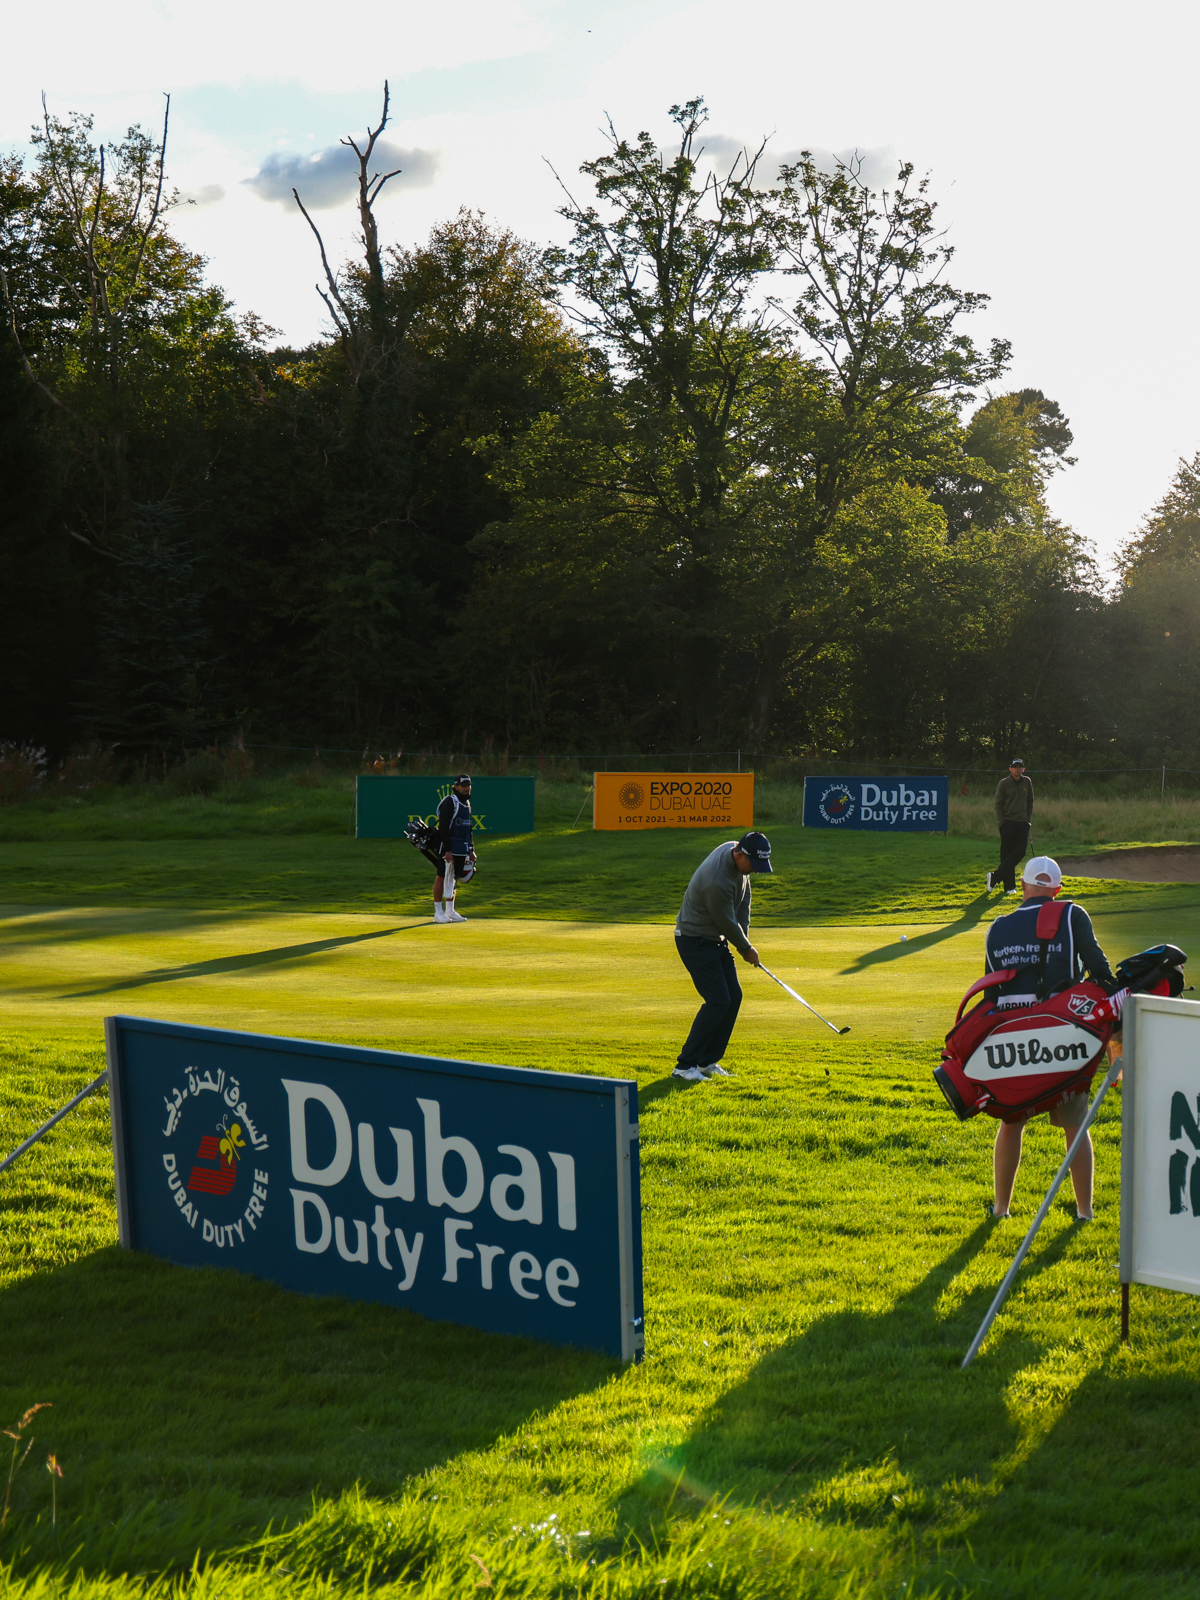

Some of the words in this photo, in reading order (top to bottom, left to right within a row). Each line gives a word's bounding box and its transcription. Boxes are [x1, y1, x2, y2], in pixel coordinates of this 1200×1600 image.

[650, 782, 693, 796] EXPO
[694, 782, 732, 795] 2020
[860, 783, 938, 807] Dubai
[650, 796, 696, 810] DUBAI
[700, 796, 731, 810] UAE
[645, 815, 666, 823] 2021
[677, 815, 686, 823] 31
[830, 816, 846, 825] DUTY
[845, 804, 856, 819] FREE
[860, 806, 899, 825] Duty
[902, 806, 938, 821] Free
[993, 944, 1025, 958] Northern
[1025, 943, 1062, 953] Irend
[1001, 955, 1020, 968] Made
[1072, 997, 1084, 1007] W
[1081, 1005, 1090, 1013] S
[984, 1038, 1089, 1070] Wilson
[280, 1077, 578, 1232] Dubai
[162, 1153, 199, 1230] DUBAI
[202, 1218, 246, 1249] DUTY
[243, 1168, 269, 1231] FREE
[289, 1188, 425, 1292] Duty
[441, 1217, 581, 1308] Free
